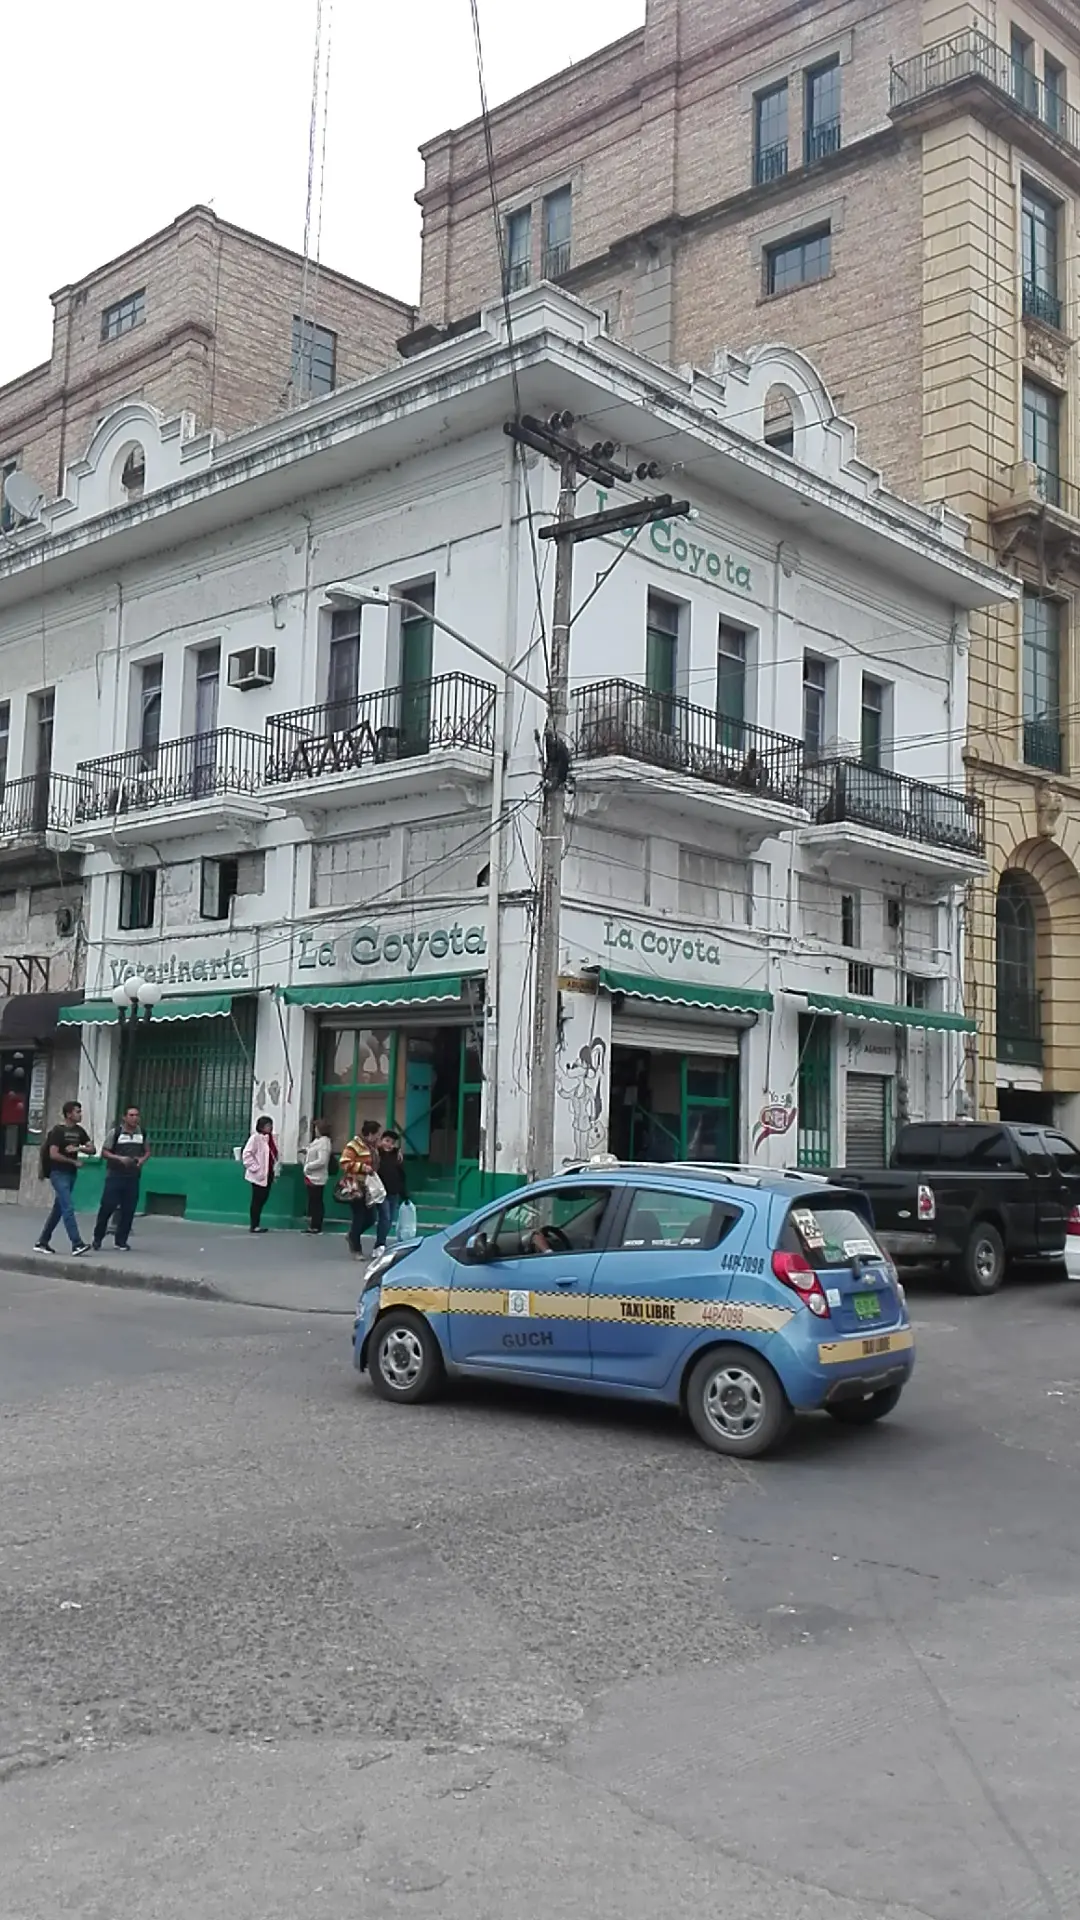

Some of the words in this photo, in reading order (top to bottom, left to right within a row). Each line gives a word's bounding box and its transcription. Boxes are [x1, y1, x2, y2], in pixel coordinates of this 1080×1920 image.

[650, 519, 752, 591] Coyota
[298, 931, 336, 969] La
[351, 921, 488, 972] Coyota
[603, 921, 634, 950] La
[641, 930, 721, 966] Coyota
[110, 948, 249, 986] Veterinaria
[620, 1302, 643, 1318] TAXI
[645, 1304, 676, 1320] LIBRE
[502, 1330, 554, 1348] GUCH
